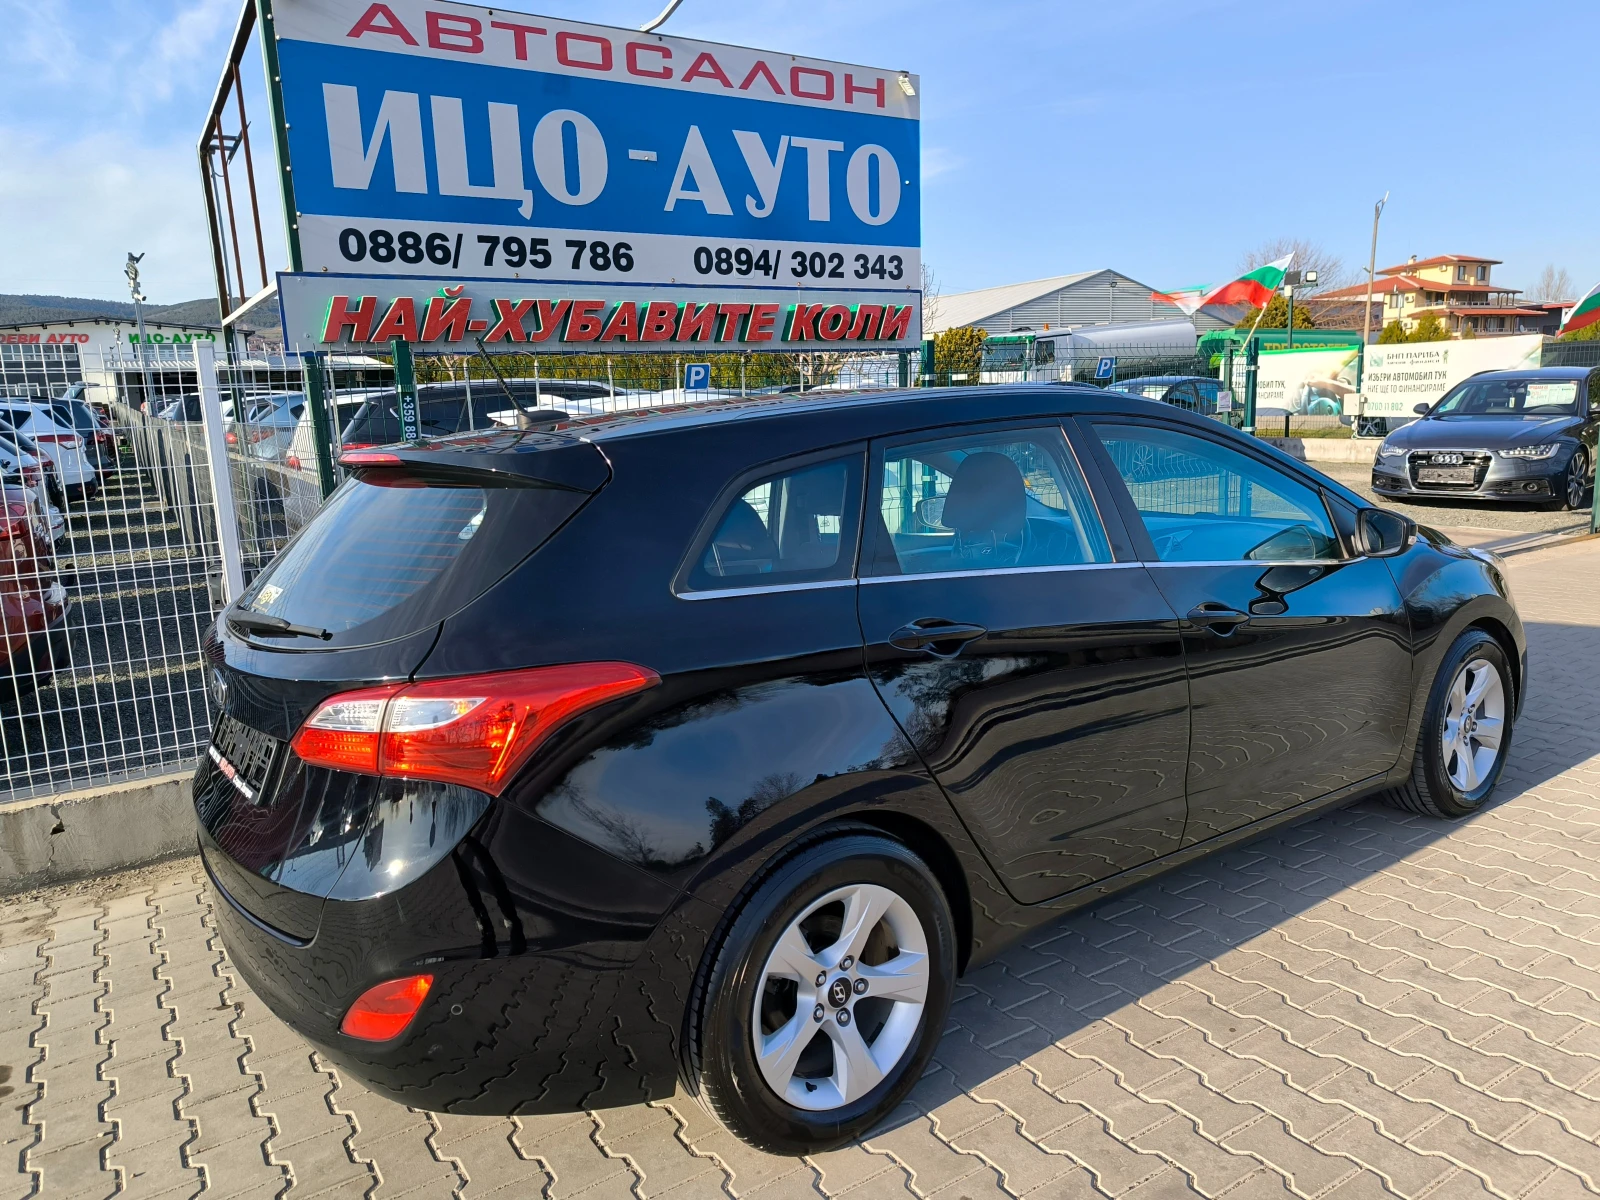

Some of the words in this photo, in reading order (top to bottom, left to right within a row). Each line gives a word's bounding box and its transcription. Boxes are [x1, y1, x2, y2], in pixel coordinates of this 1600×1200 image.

[346, 2, 886, 108] АВТОСАЛОН
[337, 227, 464, 270] 0886/
[476, 234, 552, 269] 795
[565, 238, 635, 273] 786
[692, 245, 782, 280] 0894/
[790, 249, 845, 279] 302
[853, 252, 904, 281] 343
[320, 284, 780, 343] НАЙ-ХУБАВИТЕ
[784, 303, 913, 342] КОЛИ
[48, 334, 89, 344] АУТО
[1406, 351, 1440, 359] ПАРИБА
[1099, 359, 1111, 375] P
[1368, 372, 1391, 382] ИЗБЕРИ
[1392, 371, 1433, 381] АВТОМОБИЛ
[1434, 370, 1447, 380] ТУК
[690, 366, 705, 387] P
[1367, 384, 1379, 393] НИЕ
[1398, 382, 1446, 393] ФИНАНСИРАМЕ
[403, 395, 415, 422] +359
[405, 425, 417, 439] 88
